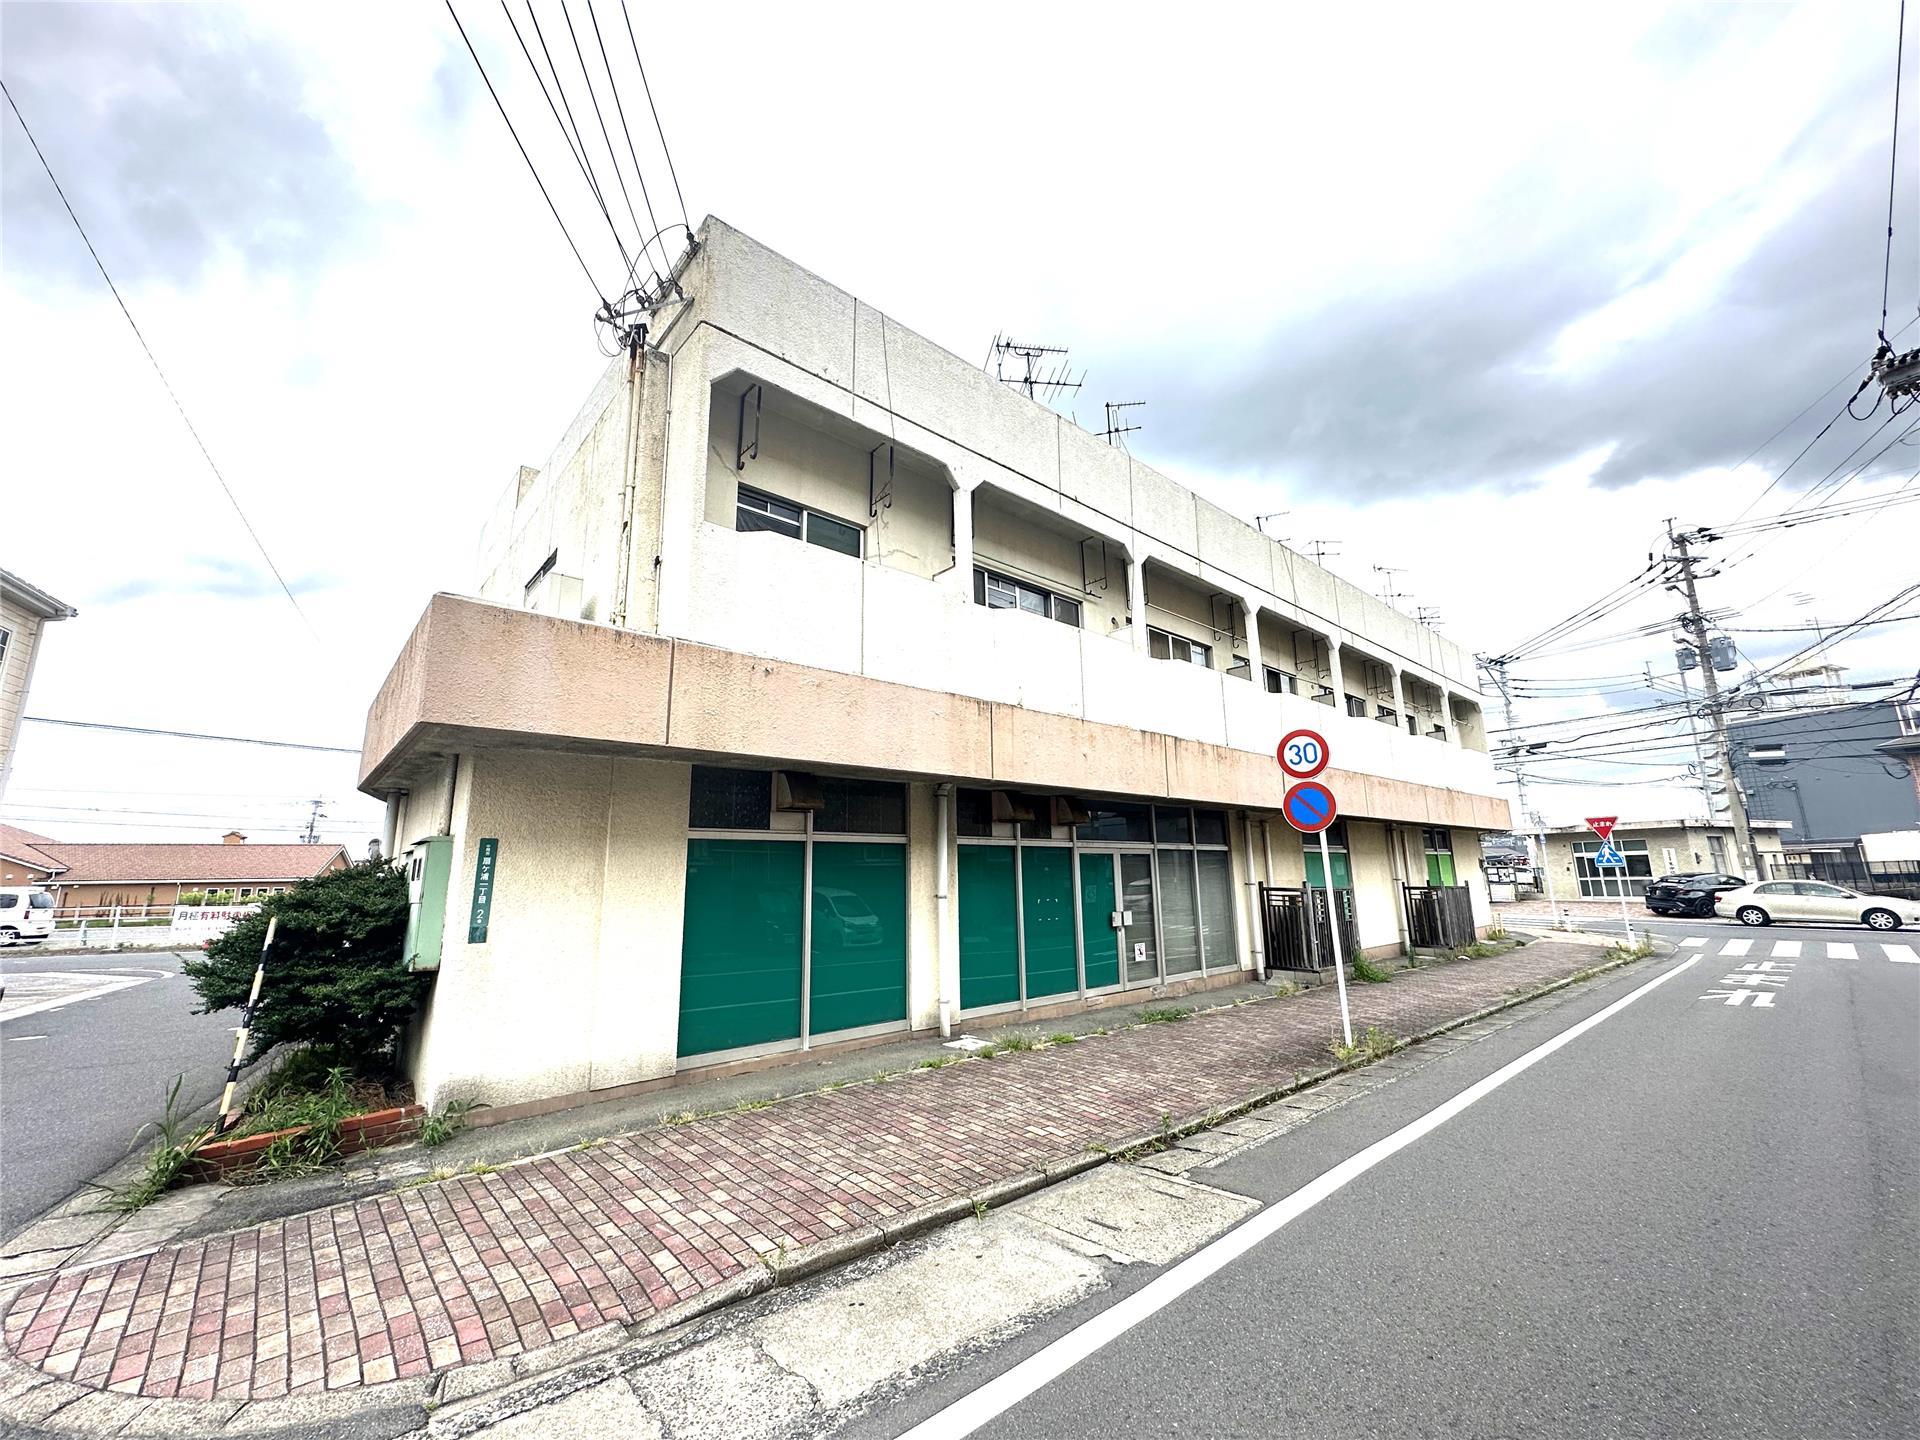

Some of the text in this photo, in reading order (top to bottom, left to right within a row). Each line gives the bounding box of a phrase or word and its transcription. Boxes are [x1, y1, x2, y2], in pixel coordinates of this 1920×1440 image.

[1288, 742, 1318, 766] 30
[1698, 961, 1797, 1008] 止まれ
